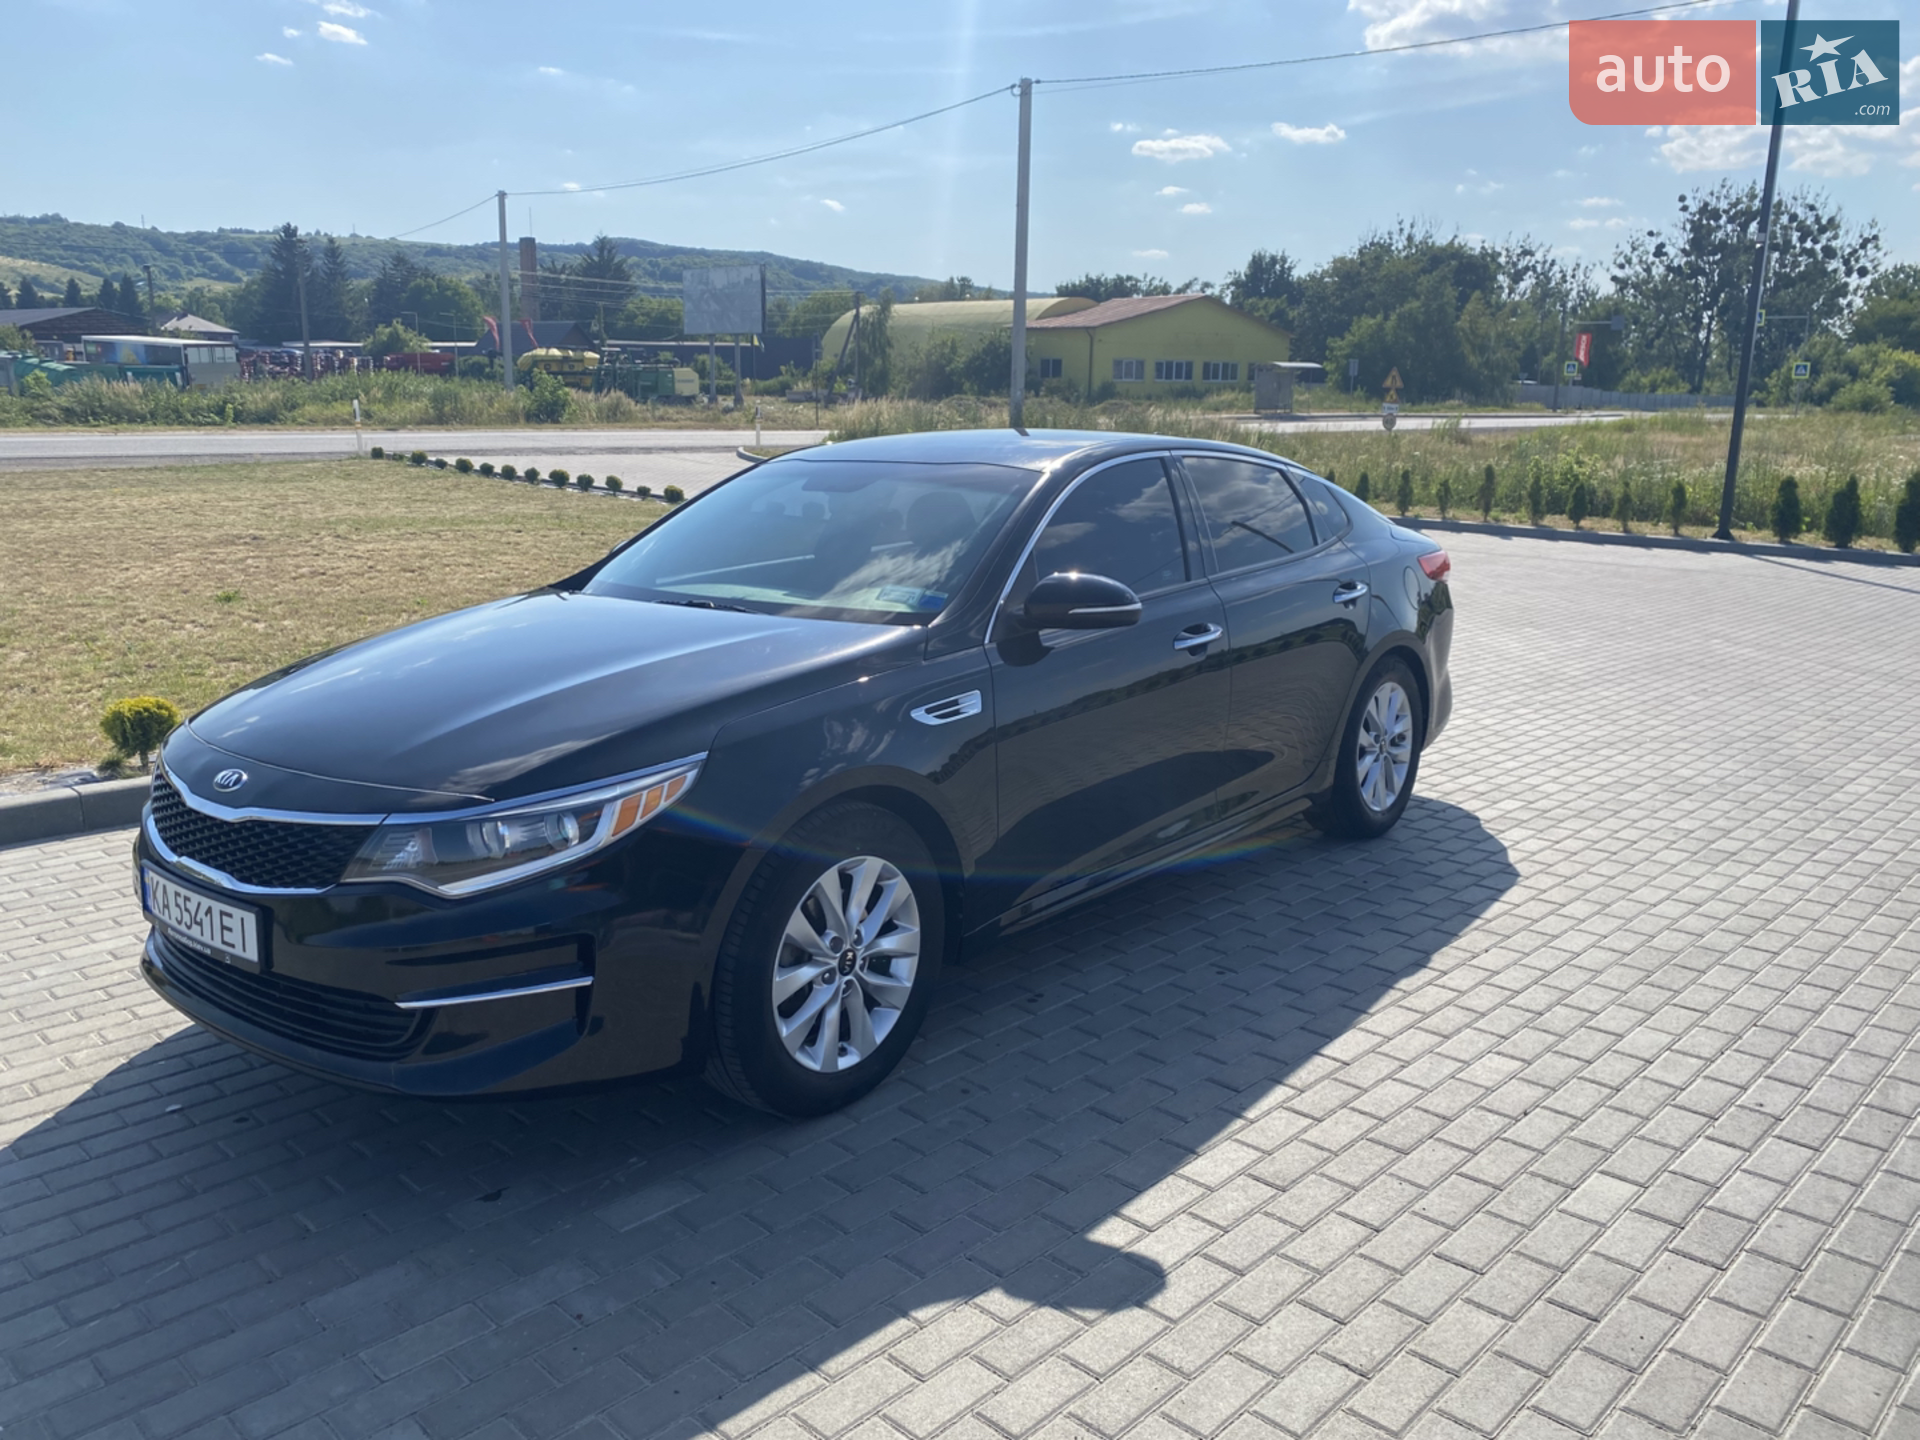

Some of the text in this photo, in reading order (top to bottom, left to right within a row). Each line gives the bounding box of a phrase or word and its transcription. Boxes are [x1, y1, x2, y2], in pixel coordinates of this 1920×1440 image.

[150, 876, 171, 921] KA
[174, 890, 214, 942] 5541
[219, 909, 246, 953] EI
